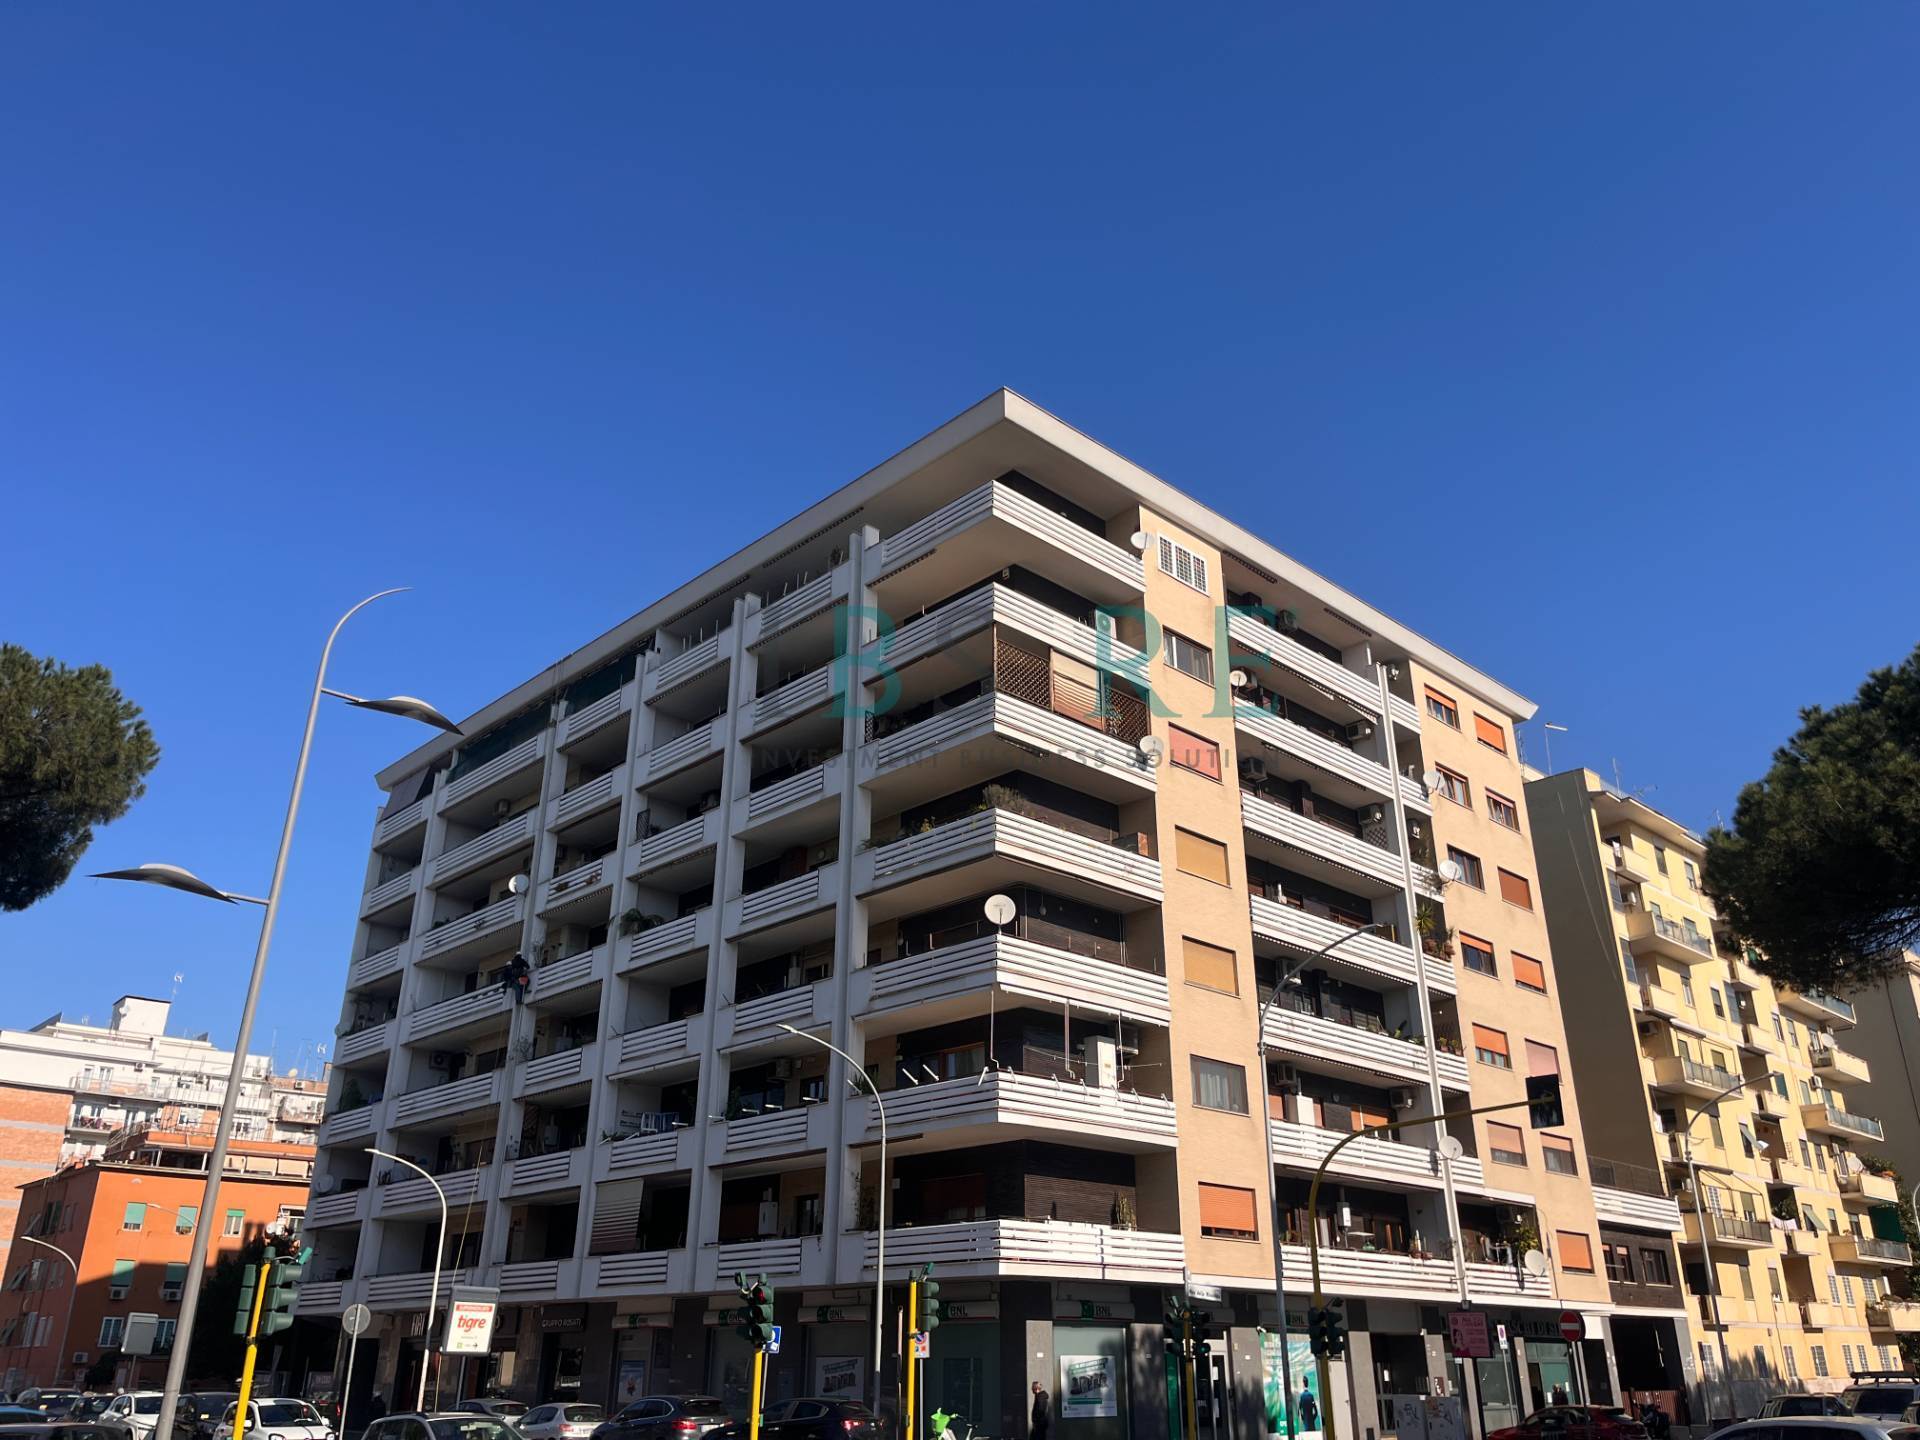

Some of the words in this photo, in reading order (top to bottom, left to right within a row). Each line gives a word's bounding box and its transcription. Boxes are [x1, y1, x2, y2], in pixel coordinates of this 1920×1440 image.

[829, 1309, 845, 1320] BNL
[949, 1304, 968, 1317] BNL
[1096, 1305, 1113, 1317] BNL
[457, 1315, 487, 1333] tigre
